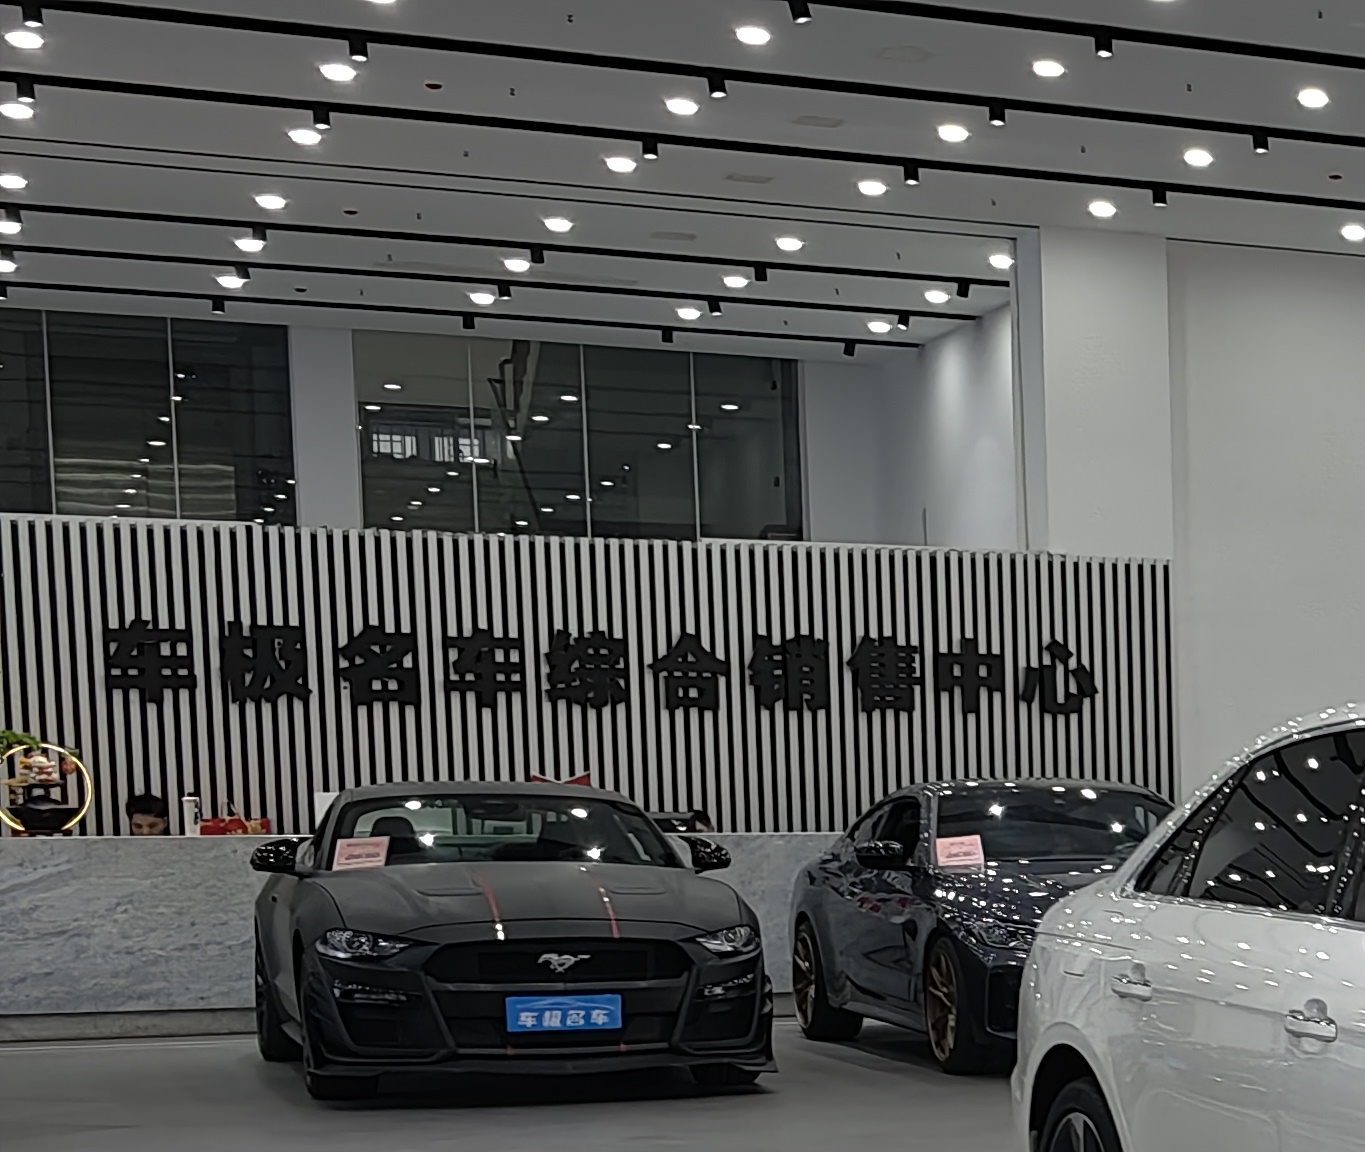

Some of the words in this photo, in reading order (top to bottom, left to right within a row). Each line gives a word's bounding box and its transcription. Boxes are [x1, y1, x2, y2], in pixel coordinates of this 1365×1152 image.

[104, 618, 1098, 714] 车极名车综合销售中心
[518, 1009, 611, 1028] 车极名车
